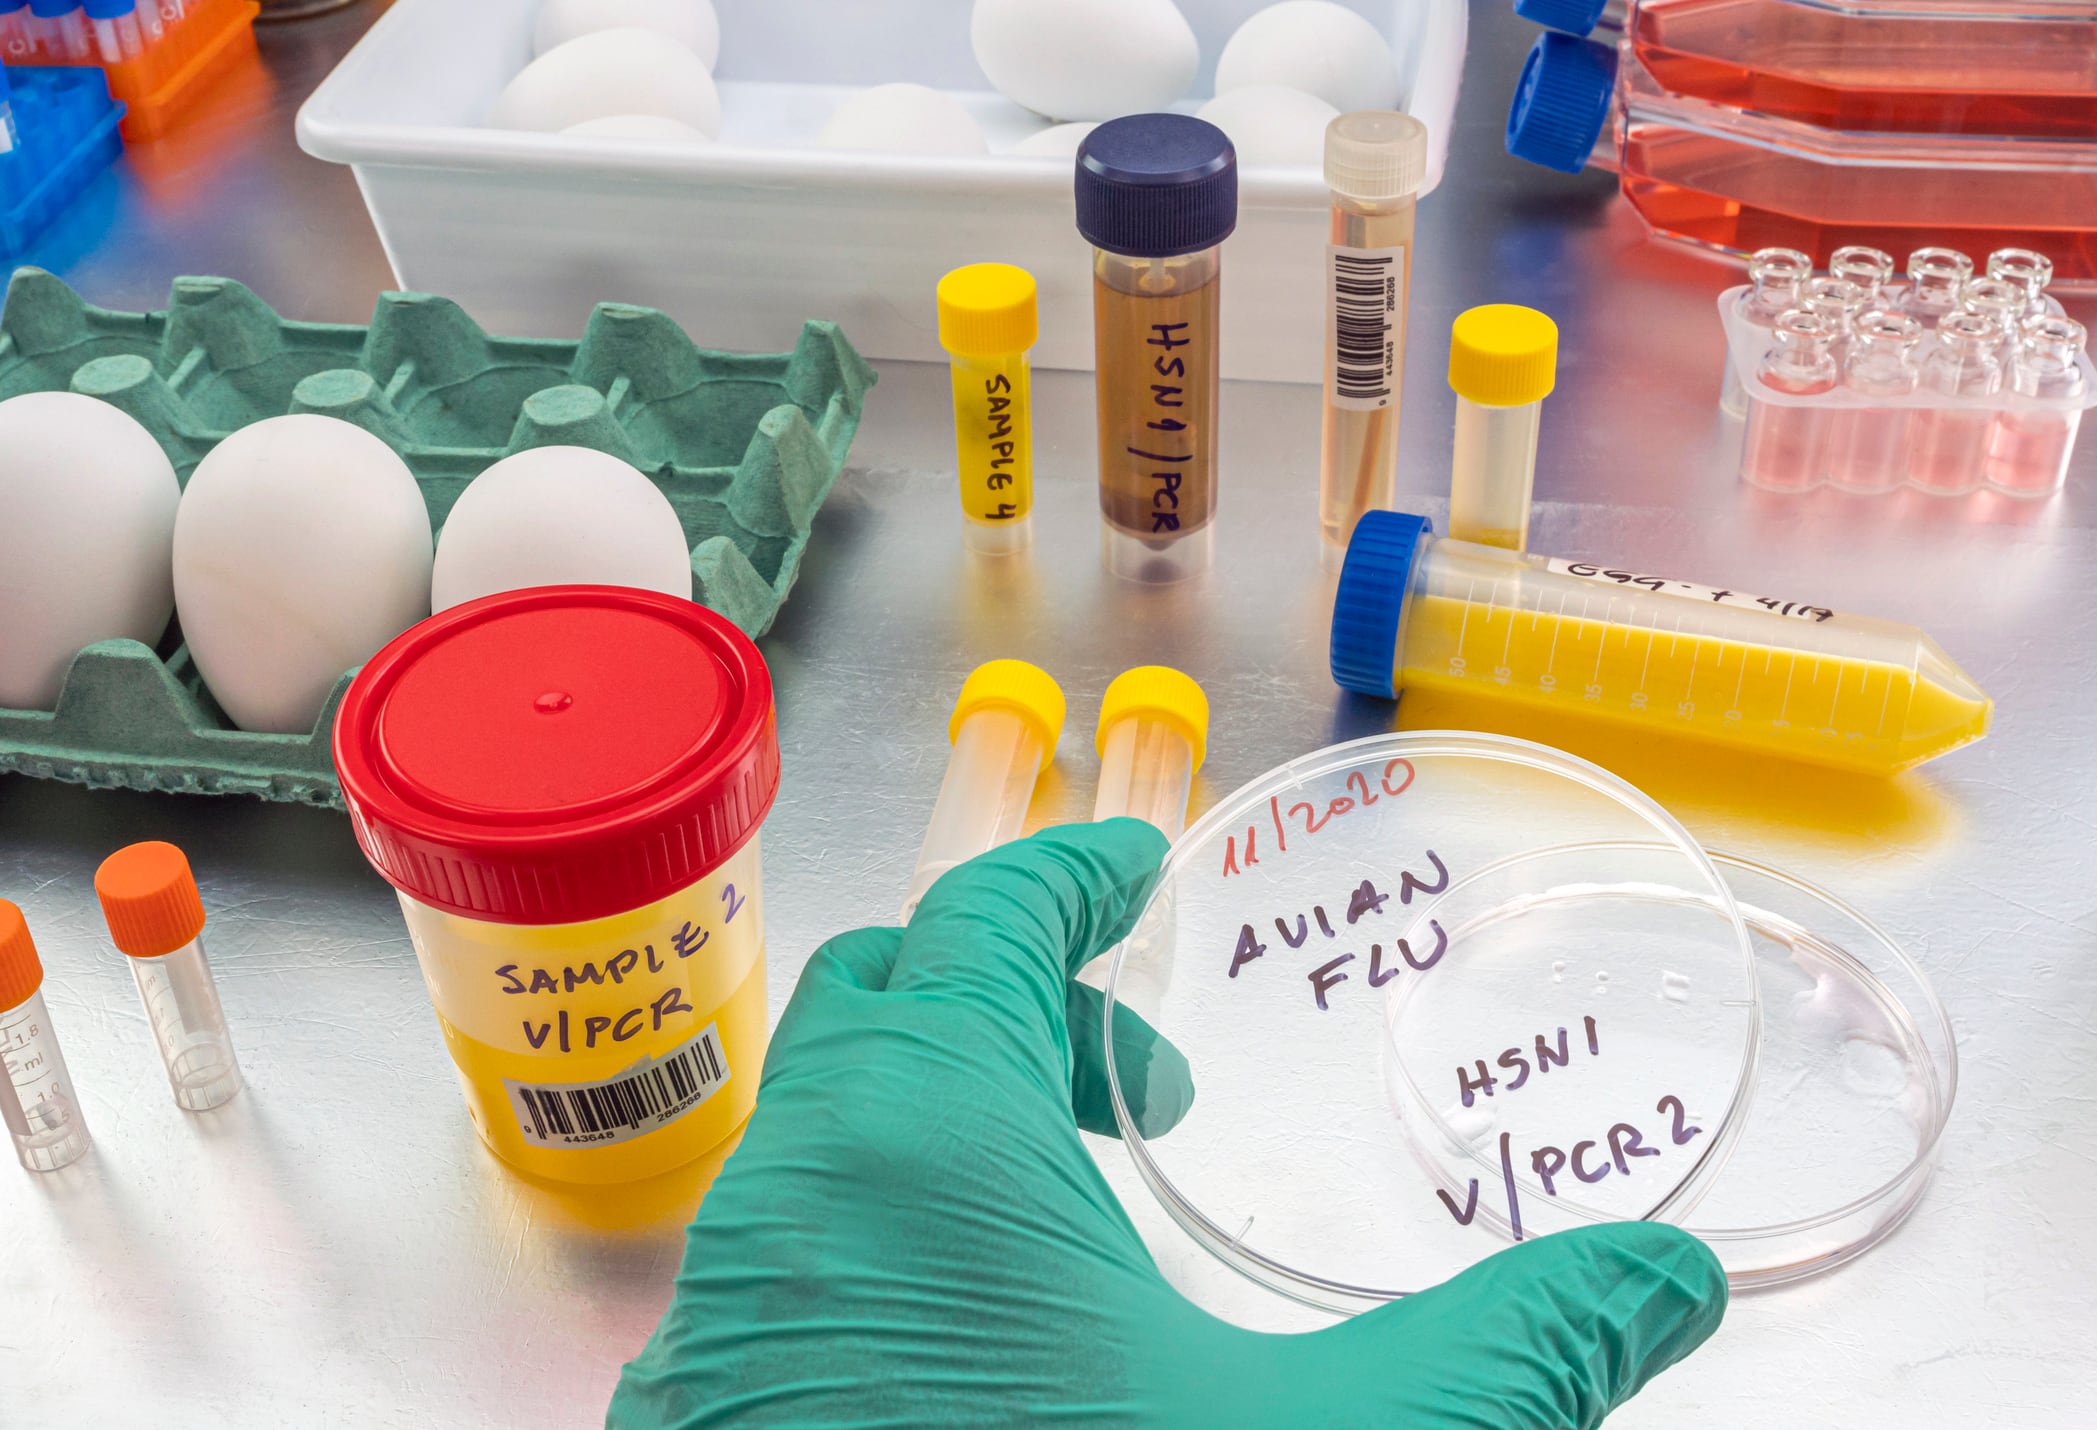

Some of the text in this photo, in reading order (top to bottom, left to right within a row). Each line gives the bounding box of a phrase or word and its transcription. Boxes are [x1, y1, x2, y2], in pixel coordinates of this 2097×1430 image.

[1386, 276, 1395, 312] 286268
[985, 373, 1017, 520] SAMPLE 4
[1449, 656, 1466, 678] 50
[1223, 758, 1415, 877] 11/2020
[495, 921, 709, 994] SAMPLE
[722, 883, 745, 924] 2
[1228, 849, 1449, 978] AVIAN
[1308, 919, 1448, 1010] FLU
[15, 1024, 39, 1044] 1.8
[25, 1052, 43, 1070] ml
[37, 1081, 60, 1102] 1.0
[563, 1130, 615, 1143] 443648
[656, 1092, 701, 1123] 286268
